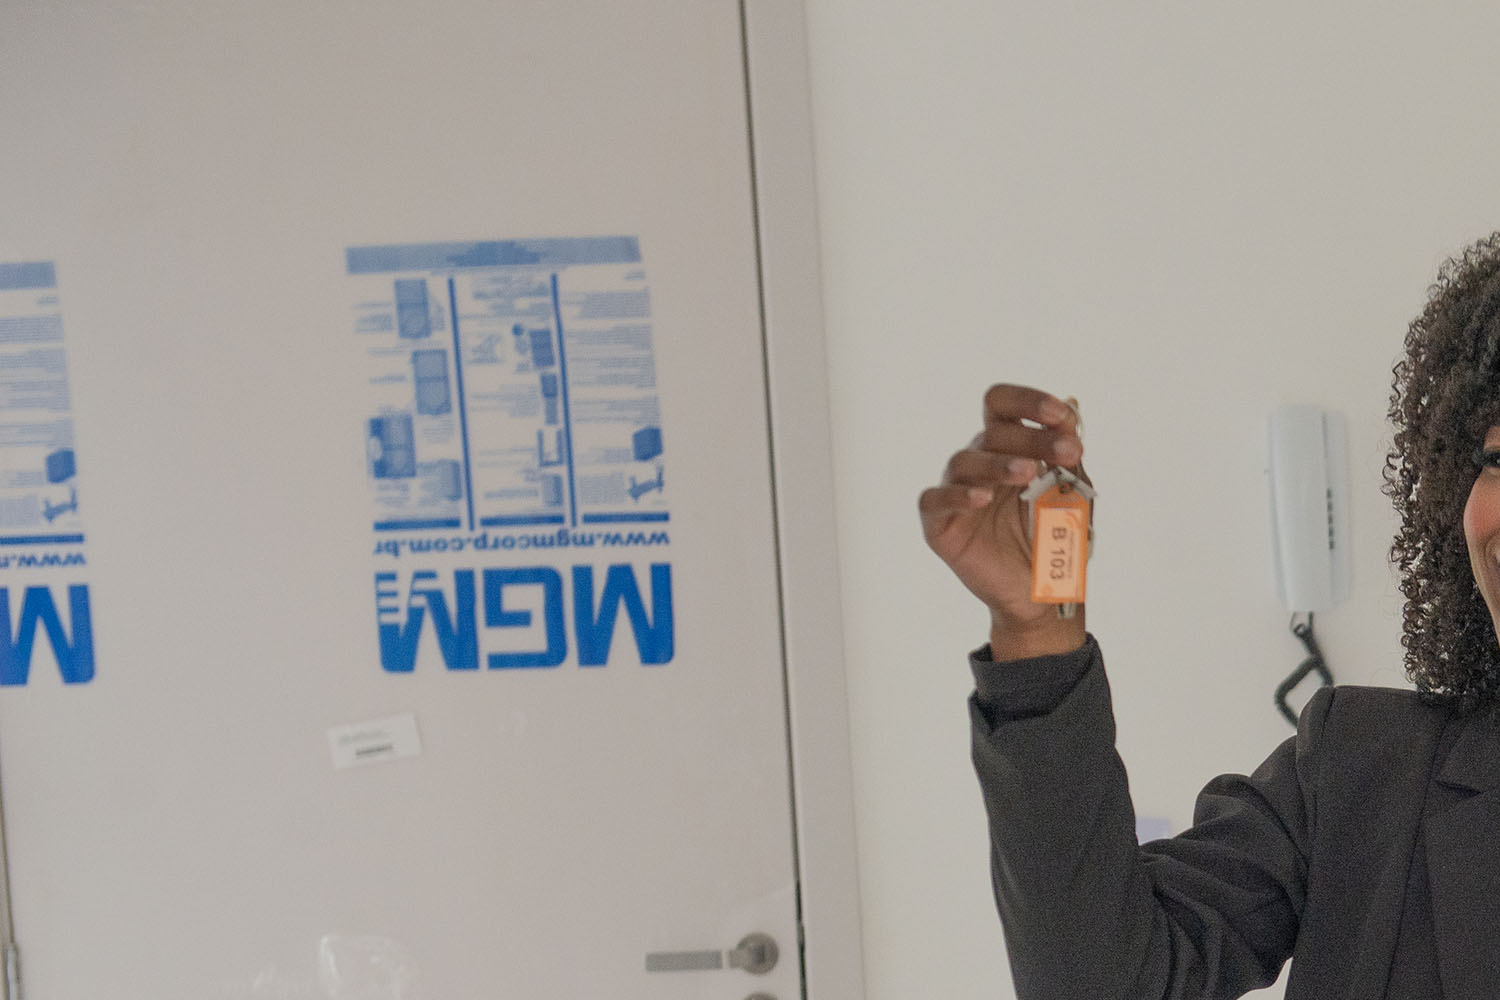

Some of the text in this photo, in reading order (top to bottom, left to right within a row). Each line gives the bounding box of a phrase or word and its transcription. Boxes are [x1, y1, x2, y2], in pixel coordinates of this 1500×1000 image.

[373, 528, 671, 557] www.mgmcorp.com.br
[1050, 526, 1067, 580] B 103
[374, 561, 676, 674] MGM
